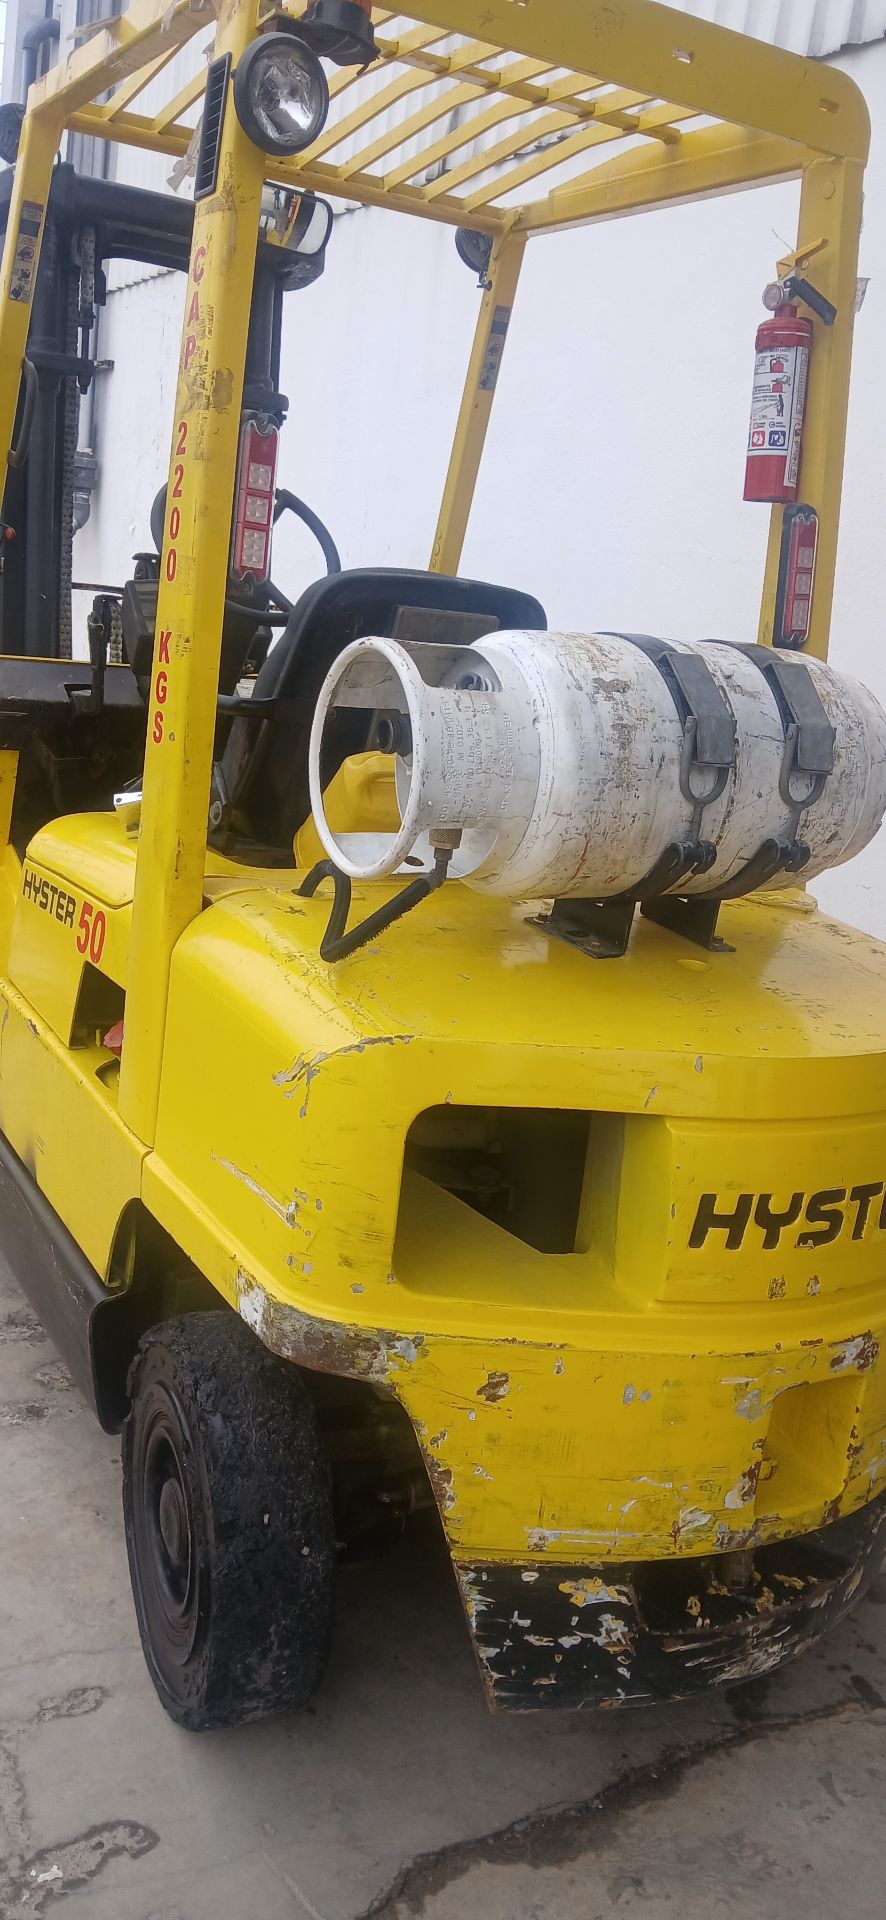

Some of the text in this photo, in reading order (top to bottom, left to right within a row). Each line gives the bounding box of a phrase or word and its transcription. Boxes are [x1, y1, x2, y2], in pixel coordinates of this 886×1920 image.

[152, 246, 206, 744] CAP 2200 KGS
[22, 868, 107, 964] HYSTER 50
[687, 1181, 886, 1250] HYST
